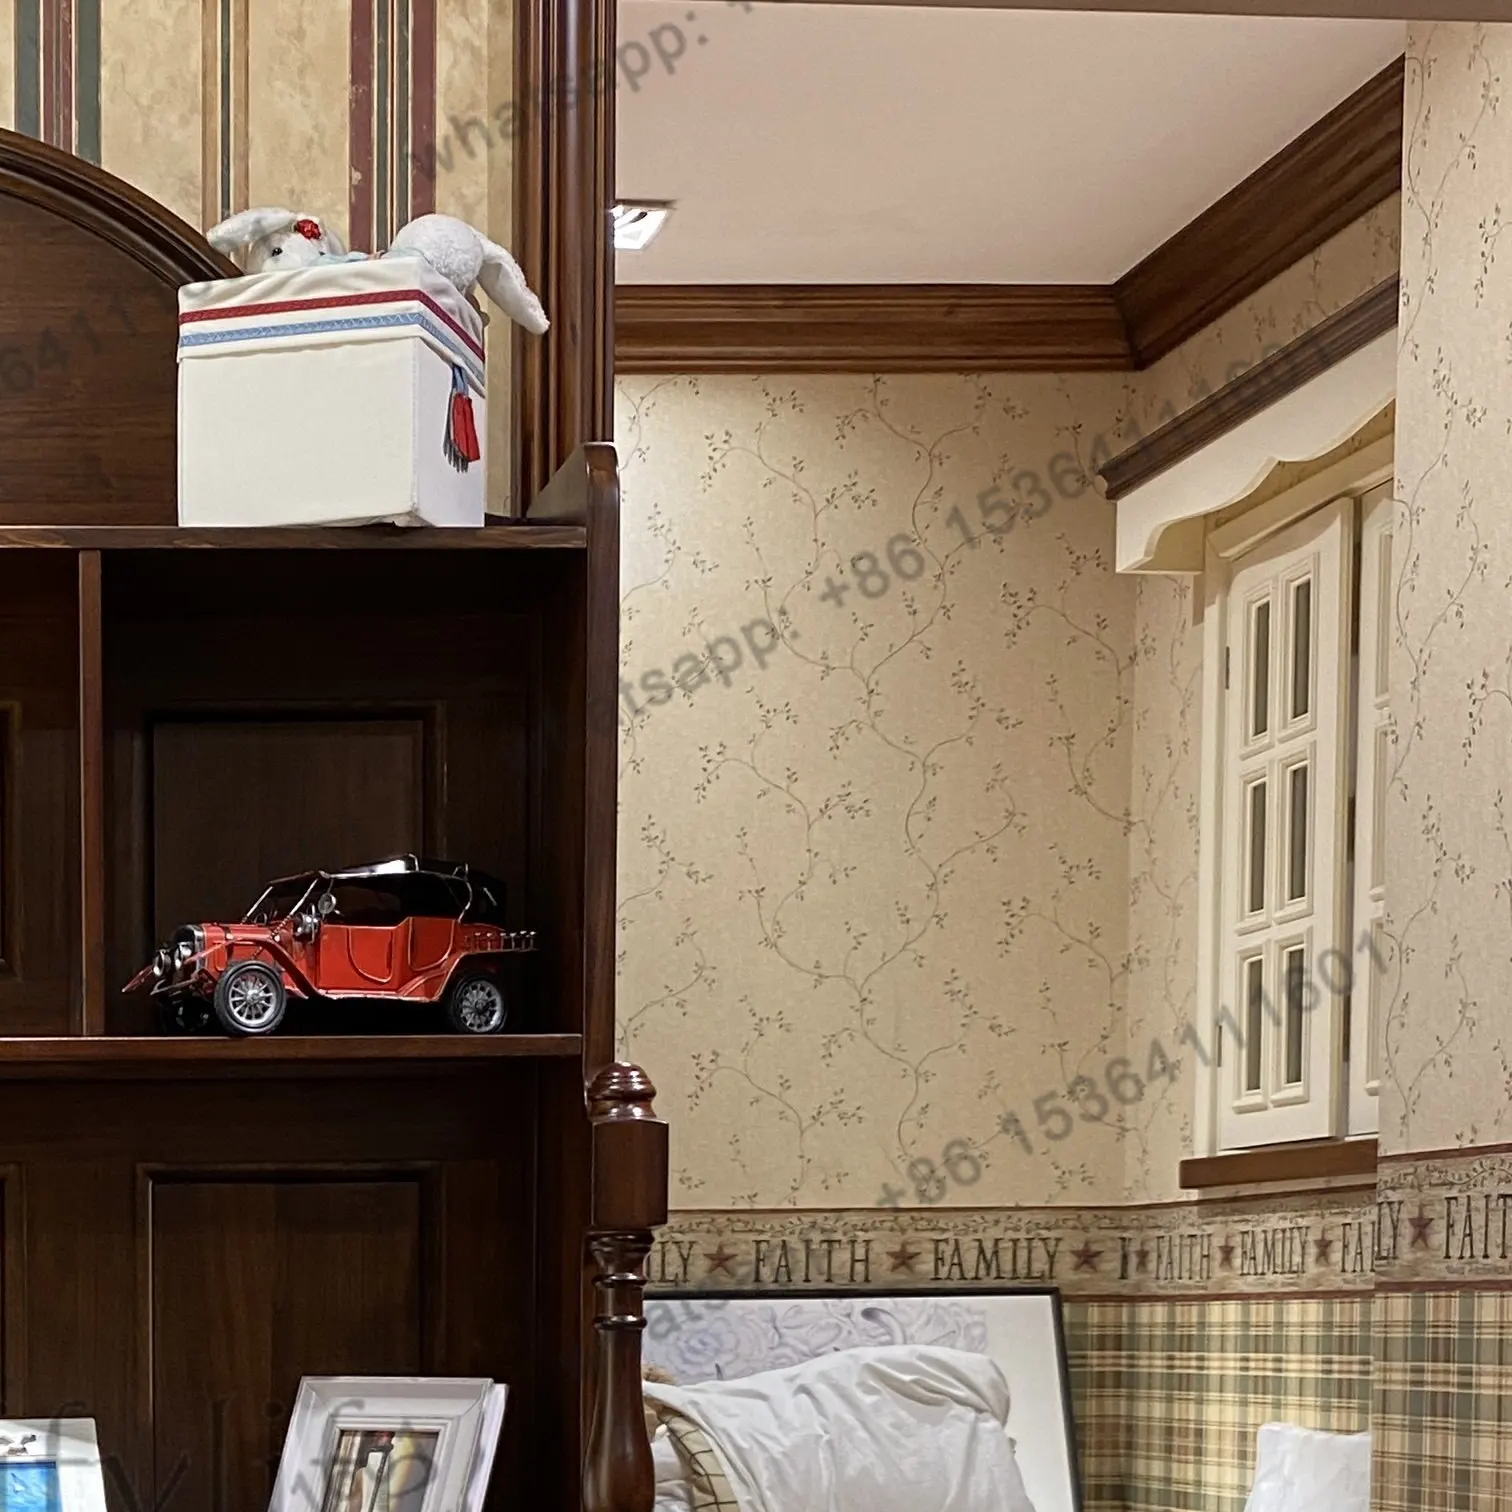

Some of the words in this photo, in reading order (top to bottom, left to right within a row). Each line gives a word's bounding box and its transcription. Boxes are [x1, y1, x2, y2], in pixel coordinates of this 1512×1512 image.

[752, 1238, 873, 1285] FAITH
[930, 1235, 1064, 1281] FAMILY
[1154, 1232, 1213, 1281] FAITH
[1238, 1225, 1311, 1276] FAMILY
